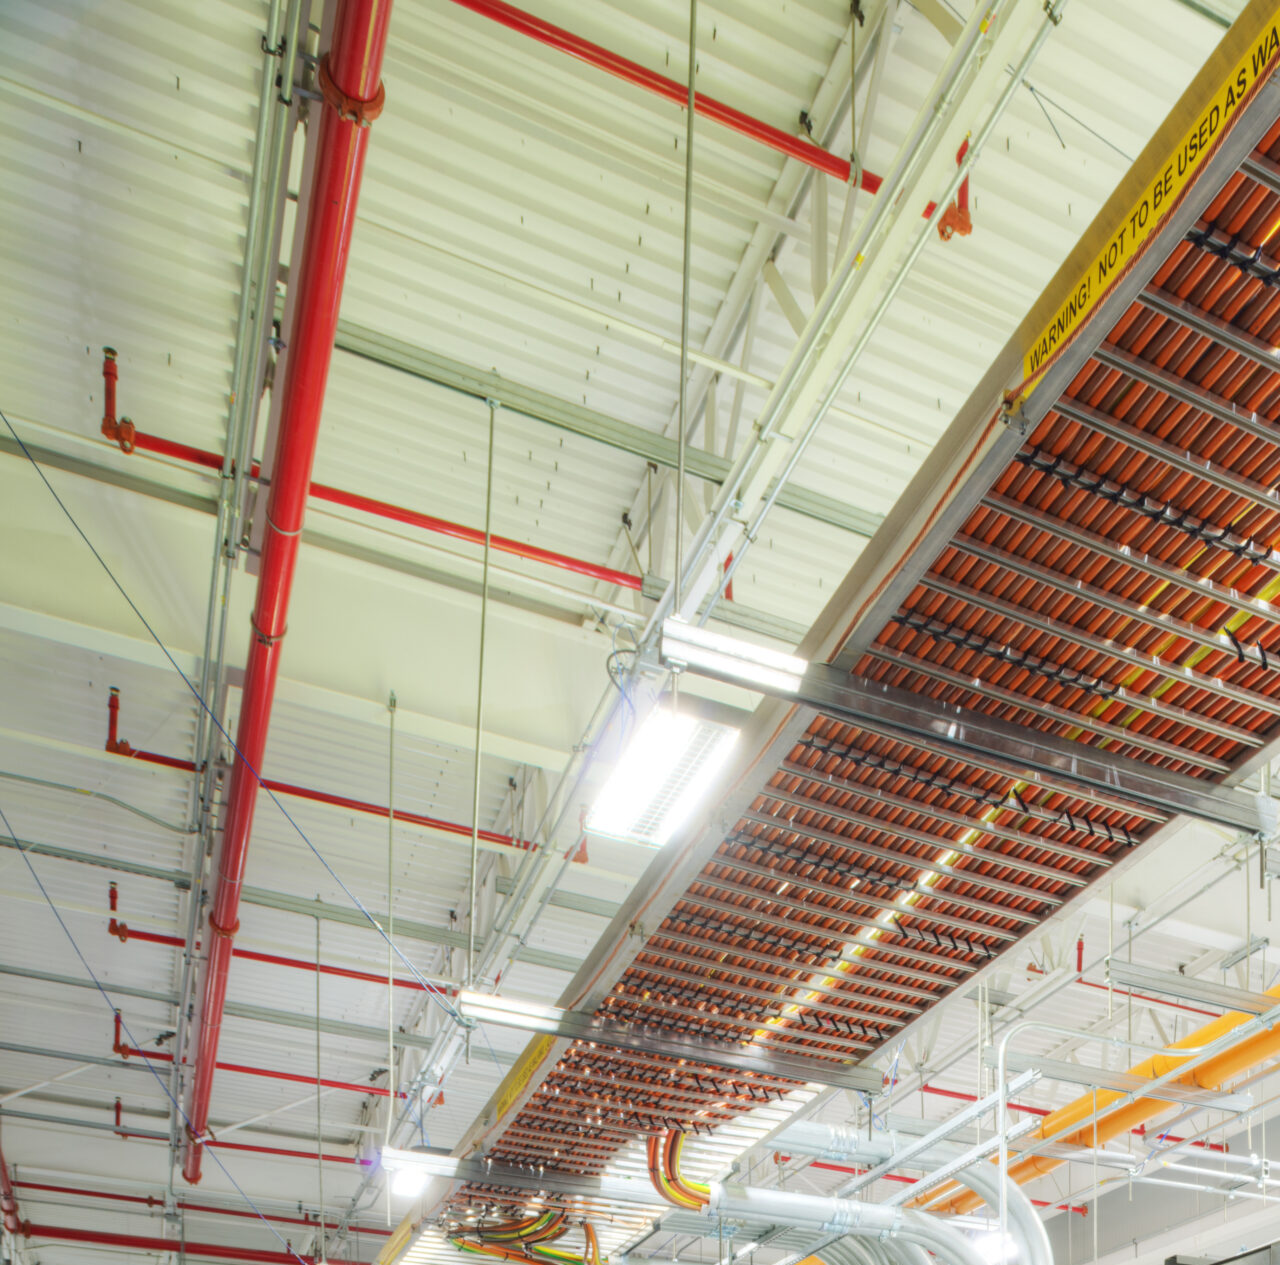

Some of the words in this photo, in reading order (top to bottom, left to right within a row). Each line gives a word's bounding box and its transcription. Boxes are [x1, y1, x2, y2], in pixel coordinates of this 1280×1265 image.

[1029, 276, 1091, 373] WARNING!
[1099, 228, 1126, 284] NOT
[1130, 201, 1149, 239] TO
[1153, 167, 1173, 210] BE
[1177, 107, 1220, 177] USED
[1224, 68, 1247, 117] AS
